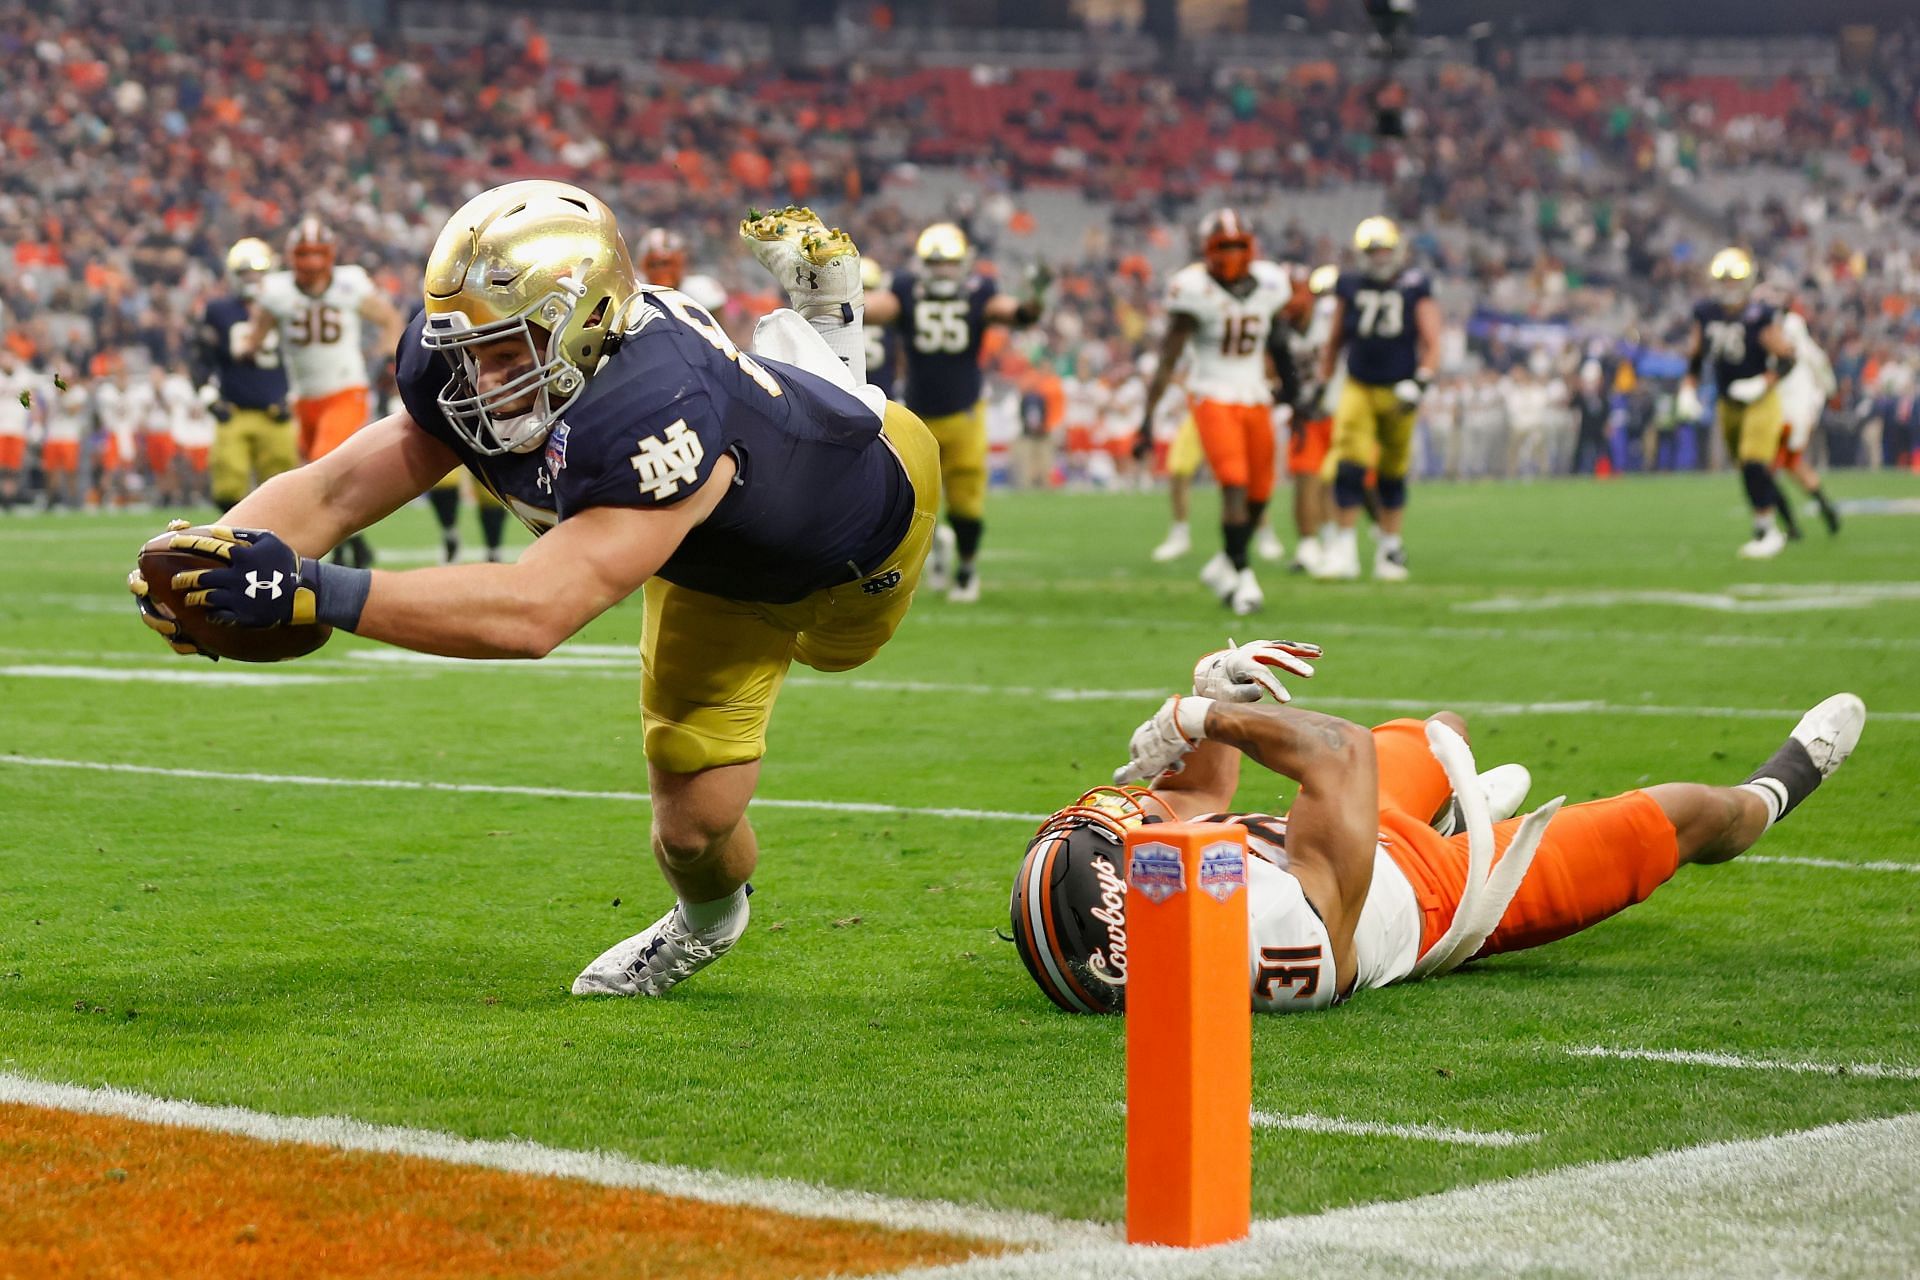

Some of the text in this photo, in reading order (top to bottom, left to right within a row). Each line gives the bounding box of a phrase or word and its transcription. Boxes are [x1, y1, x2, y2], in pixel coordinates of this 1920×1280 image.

[914, 301, 970, 353] 55
[1220, 315, 1262, 357] 16
[1354, 290, 1403, 338] 73
[1088, 854, 1127, 986] Cowboys
[1254, 944, 1322, 1001] 31
